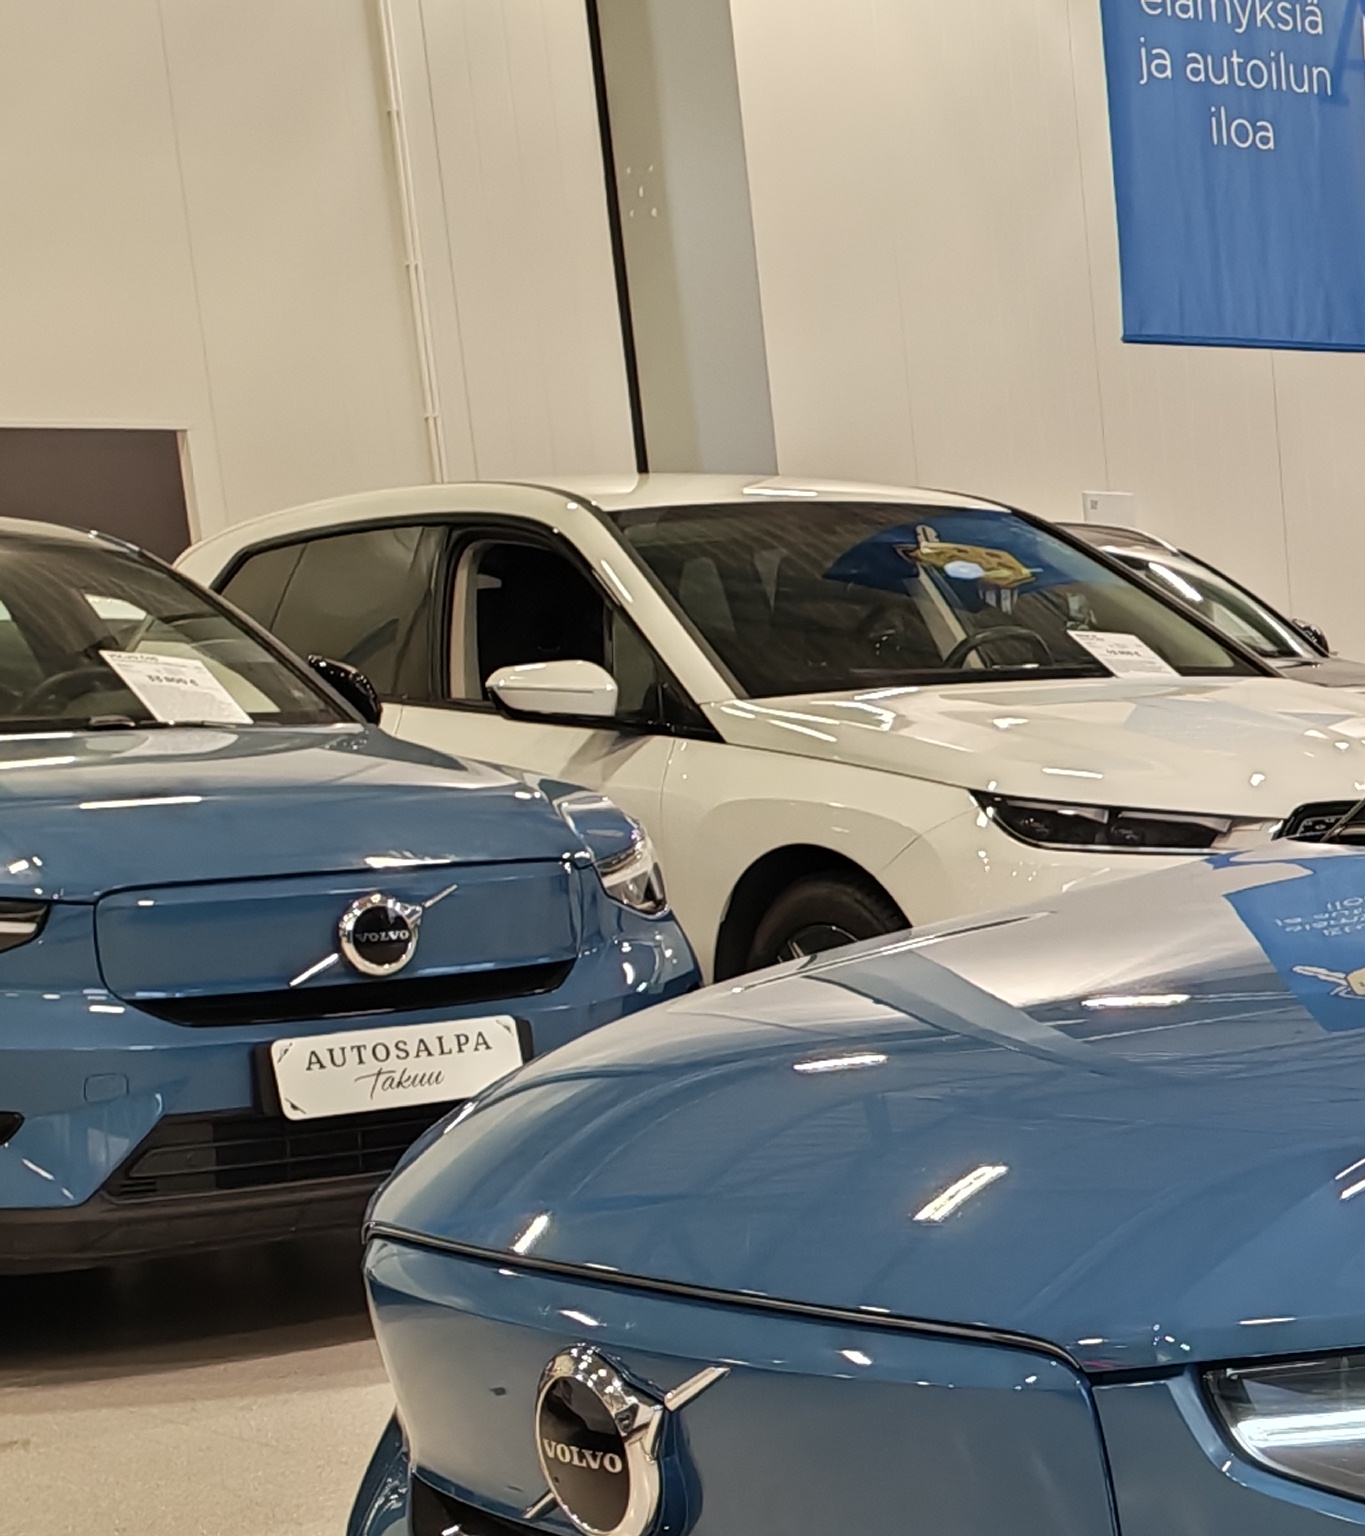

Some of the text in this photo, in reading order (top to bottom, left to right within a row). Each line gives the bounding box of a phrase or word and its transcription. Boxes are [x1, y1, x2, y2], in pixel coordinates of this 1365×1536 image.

[1138, 37, 1332, 96] ja autoilun
[1210, 106, 1275, 150] iloa
[354, 930, 410, 943] VOLVO
[304, 1030, 494, 1072] AUTOSALPA
[354, 1067, 445, 1099] Takuu
[542, 1438, 624, 1476] VOLVO
